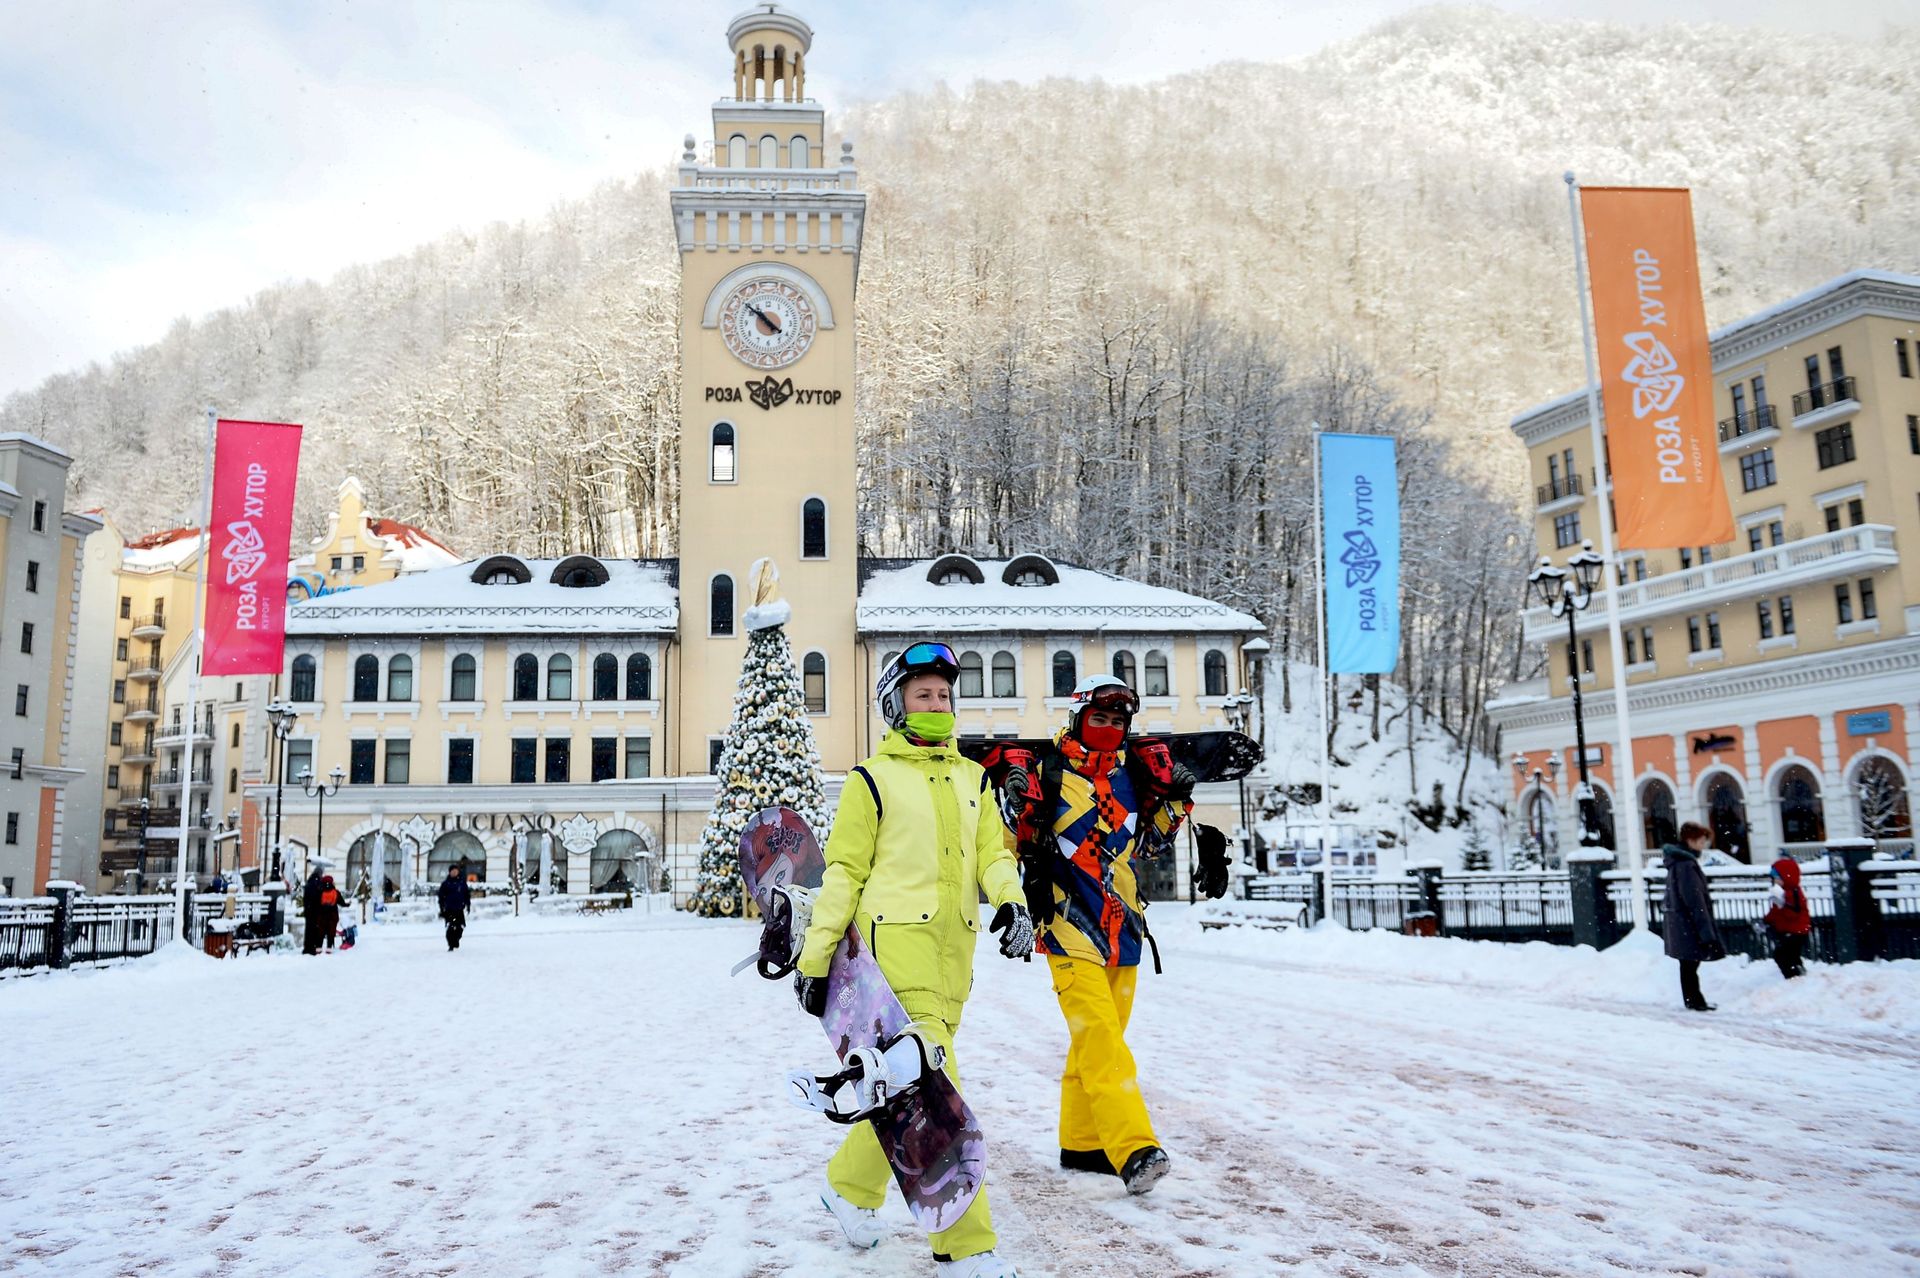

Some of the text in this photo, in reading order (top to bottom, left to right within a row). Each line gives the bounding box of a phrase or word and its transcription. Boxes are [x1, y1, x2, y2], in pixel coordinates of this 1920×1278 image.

[705, 387, 842, 405] РОЗА ХУТОР
[1633, 248, 1687, 484] РОЗА ХУТОР
[236, 462, 268, 630] РОЗА ХУТОР
[1355, 474, 1376, 631] РОЗА ХУТОР
[441, 813, 556, 831] LUCIANO
